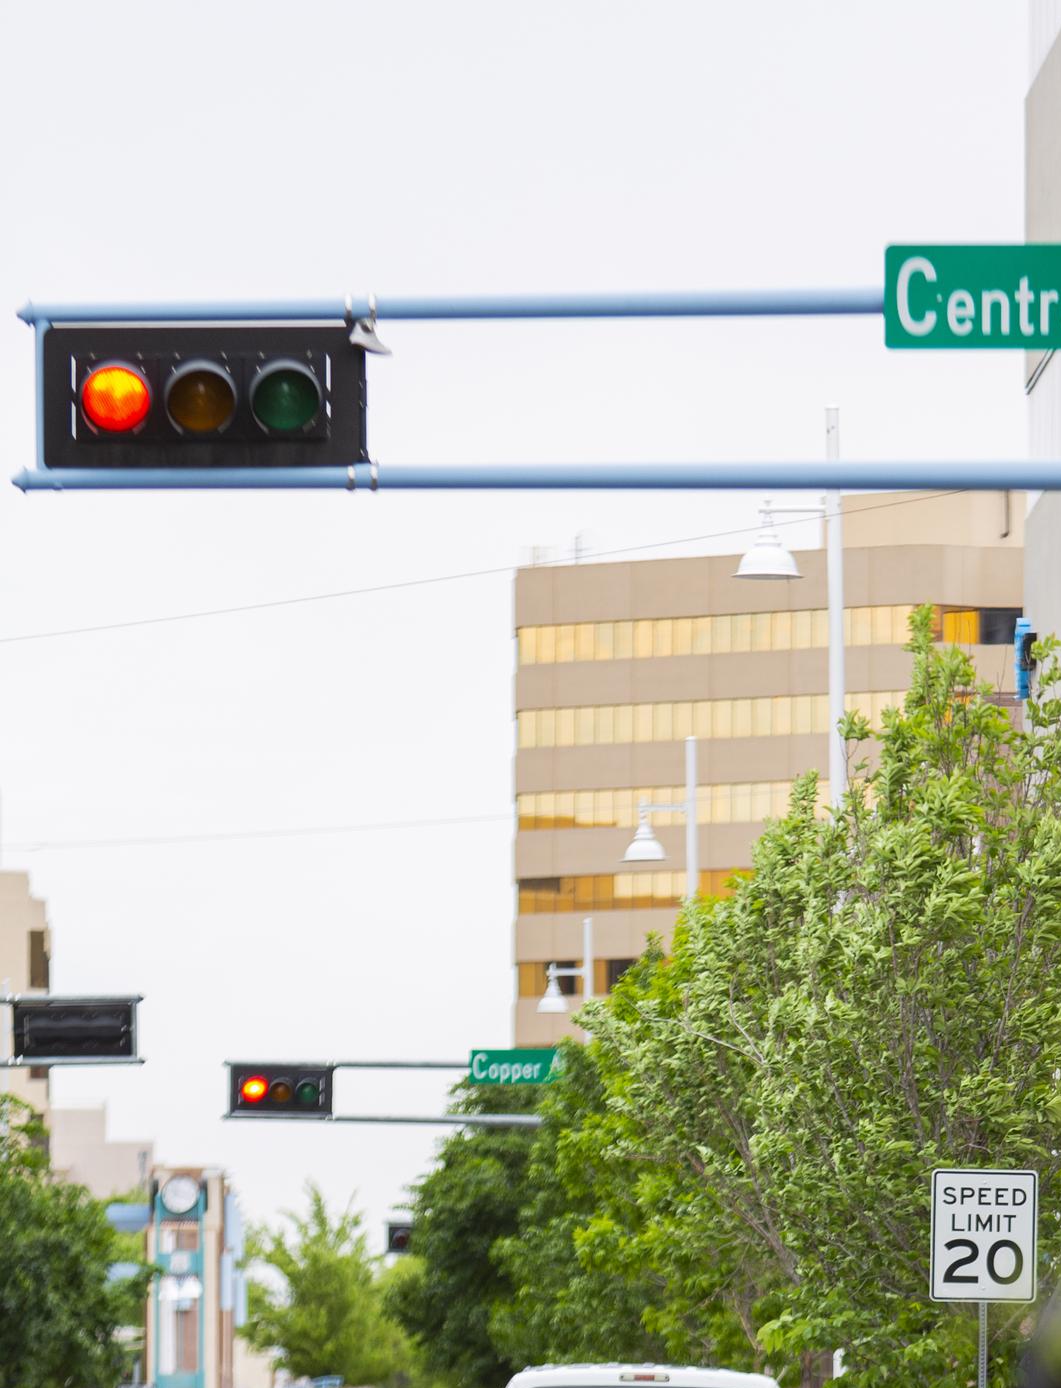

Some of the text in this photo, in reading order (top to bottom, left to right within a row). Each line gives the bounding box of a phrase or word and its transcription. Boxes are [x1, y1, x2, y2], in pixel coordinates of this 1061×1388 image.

[472, 1053, 541, 1083] Copper
[943, 1187, 1027, 1206] SPEED
[951, 1213, 1017, 1232] LIMIT
[943, 1239, 1024, 1285] 20
